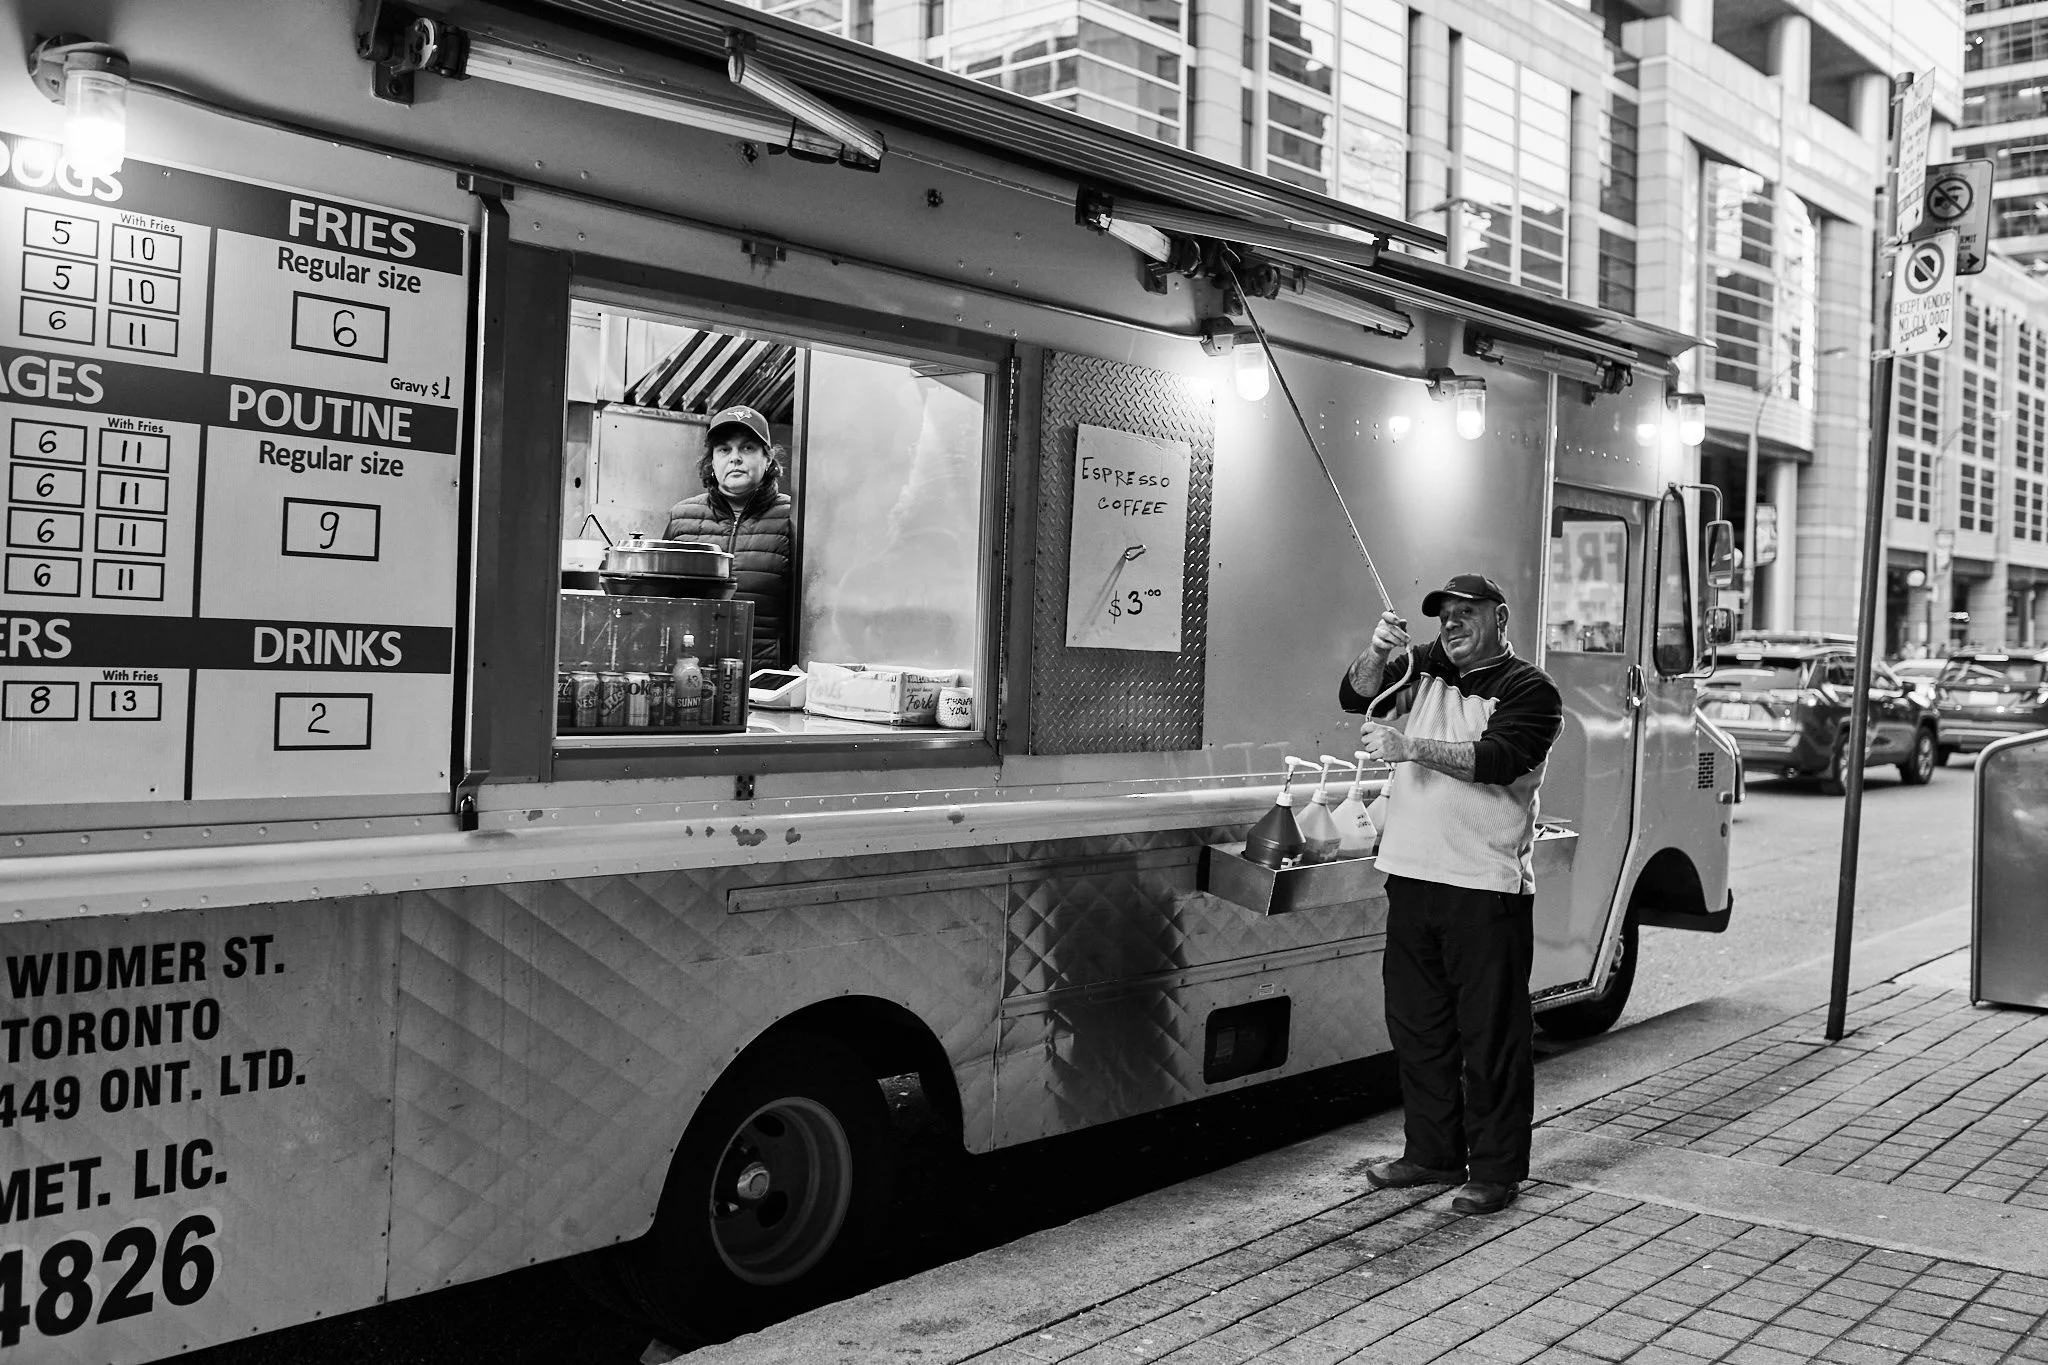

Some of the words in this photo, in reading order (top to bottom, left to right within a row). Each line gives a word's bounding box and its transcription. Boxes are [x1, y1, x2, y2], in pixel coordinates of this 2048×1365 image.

[0, 139, 123, 201] OGS
[51, 220, 71, 246] 5
[120, 212, 146, 229] With
[150, 218, 176, 233] Fries
[288, 198, 417, 258] FRIES
[129, 234, 156, 261] 10
[52, 265, 72, 291] 5
[278, 246, 371, 285] Regular
[378, 261, 422, 294] size
[127, 278, 156, 304] 10
[1923, 291, 1951, 309] VENDOR
[48, 310, 67, 330] 6
[332, 309, 358, 348] 6
[128, 322, 147, 347] 11
[390, 376, 428, 397] Gravy
[107, 417, 133, 430] With
[137, 420, 164, 433] Fries
[228, 384, 413, 444] POUTINE
[39, 430, 57, 454] 6
[121, 440, 142, 464] 11
[258, 440, 353, 475] Regular
[360, 451, 404, 477] size
[36, 473, 54, 497] 6
[1081, 457, 1170, 487] ESPRESSO
[119, 482, 139, 505] 11
[1098, 496, 1168, 517] COFFEE
[37, 518, 55, 543] 6
[118, 523, 137, 546] 11
[319, 512, 340, 549] 9
[34, 563, 51, 587] 6
[118, 568, 134, 591] 11
[253, 626, 403, 667] DRINKS
[102, 670, 129, 681] With
[133, 670, 159, 682] Fries
[30, 686, 51, 714] 8
[111, 690, 137, 712] 13
[906, 693, 933, 711] Fork
[307, 703, 331, 734] 2
[6, 940, 206, 999] WIDMER
[222, 934, 285, 979] ST.
[1, 998, 220, 1063] TORONTO
[100, 1060, 201, 1113] ONT.
[220, 1048, 305, 1096] LTD.
[134, 1138, 228, 1200] LIC.
[0, 1214, 217, 1348] 4826
